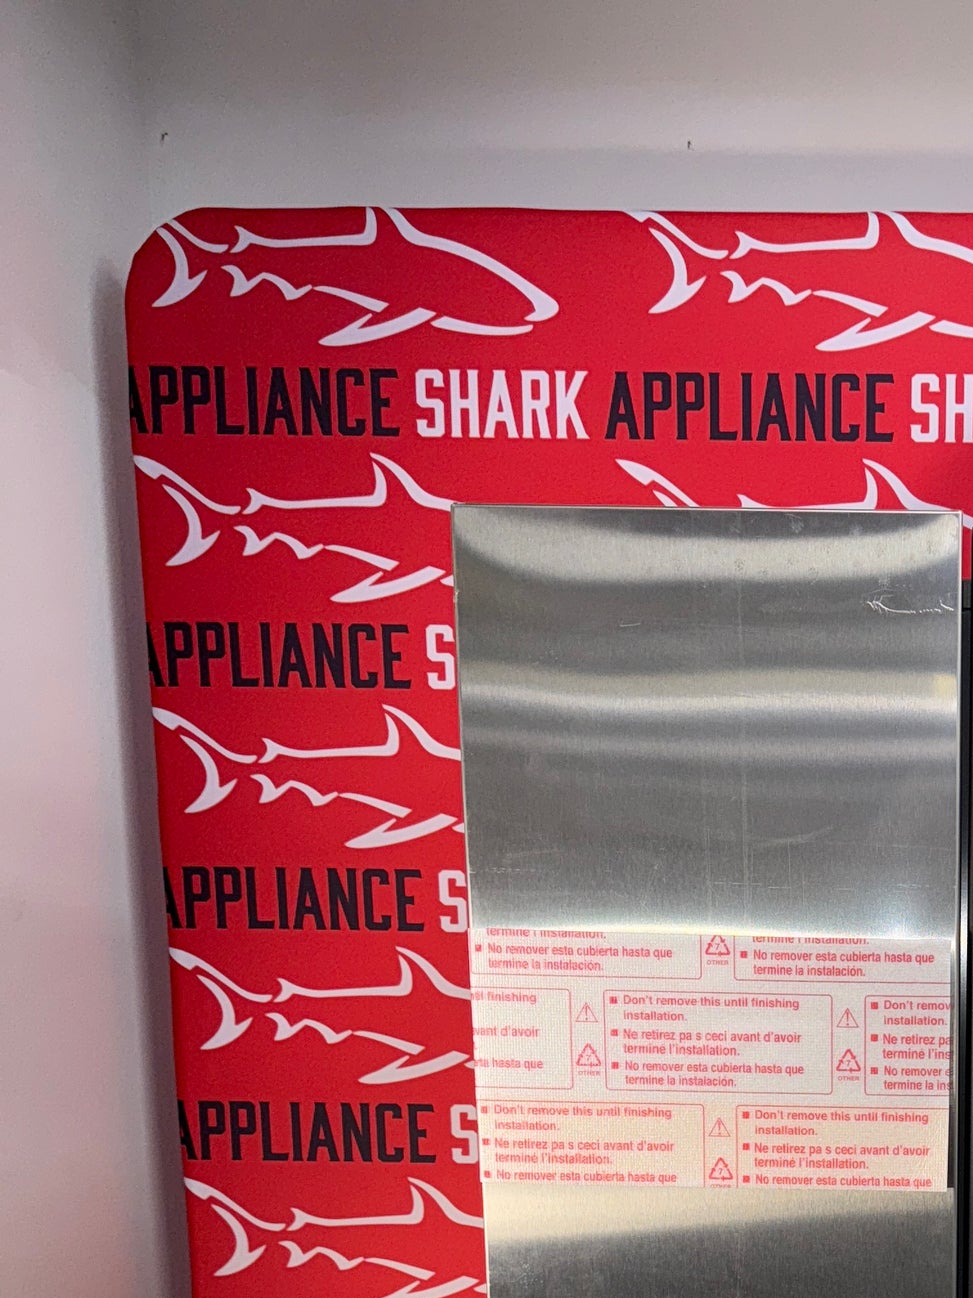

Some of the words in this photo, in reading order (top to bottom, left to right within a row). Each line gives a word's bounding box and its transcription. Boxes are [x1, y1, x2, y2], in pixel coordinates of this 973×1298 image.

[414, 368, 590, 440] SHARK
[604, 370, 895, 443] APPLIANCE
[755, 1110, 784, 1120] Don't
[787, 1112, 827, 1121] remove
[831, 1111, 851, 1121] this
[854, 1112, 878, 1122] until
[881, 1112, 928, 1125] finishing
[755, 1125, 818, 1136] installation.
[754, 1143, 769, 1153] Ne
[772, 1143, 806, 1154] retirez
[834, 1145, 857, 1155] ceci
[860, 1145, 889, 1156] avant
[892, 1145, 930, 1156] d'avoir
